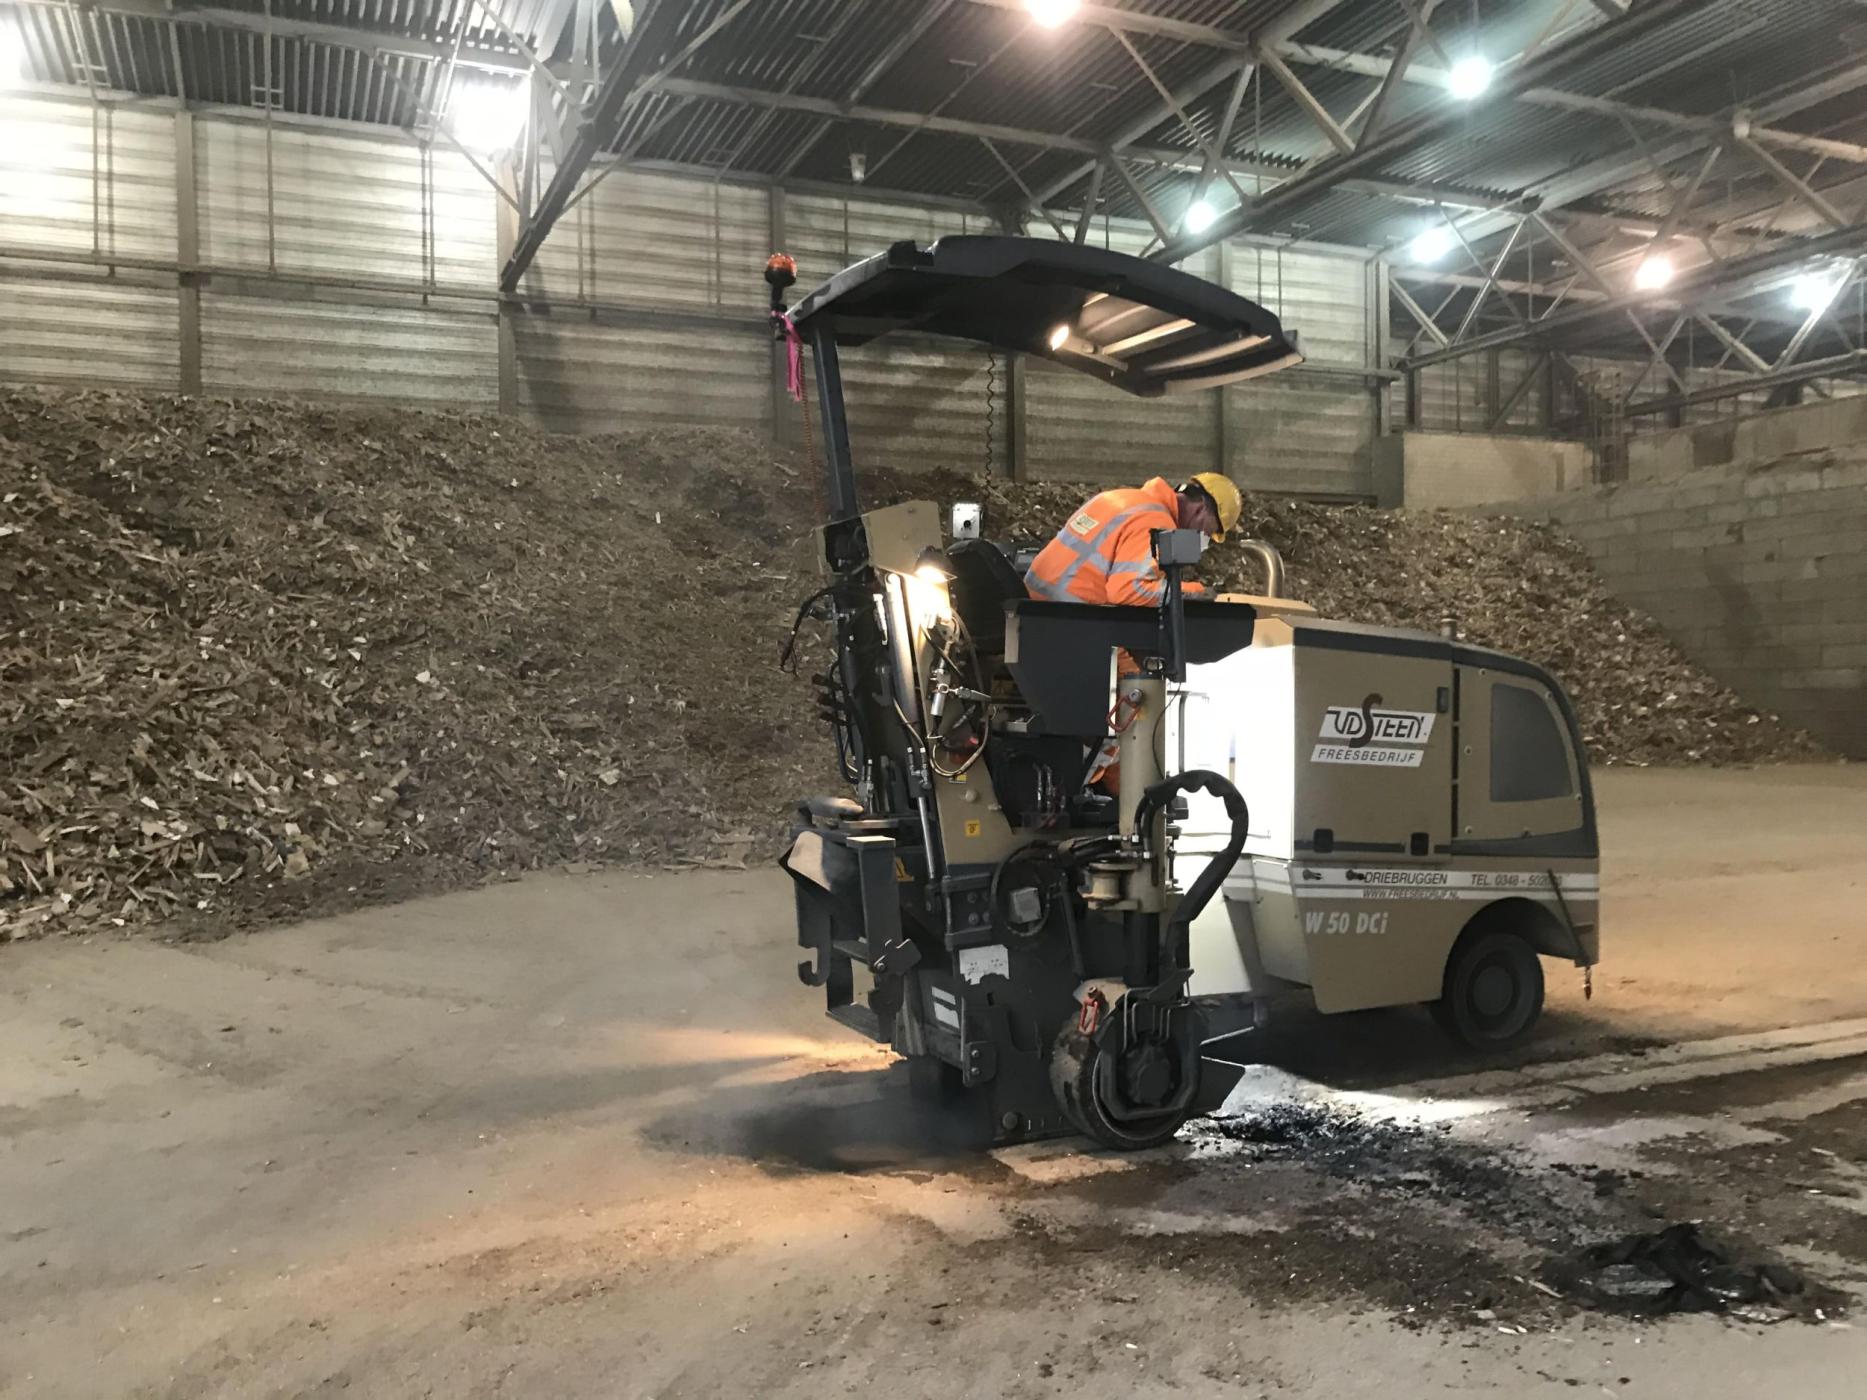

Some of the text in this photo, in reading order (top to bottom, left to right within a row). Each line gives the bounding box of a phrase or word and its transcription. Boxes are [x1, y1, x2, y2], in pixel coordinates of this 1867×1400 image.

[1318, 748, 1416, 763] FREESBEDRIJF
[1363, 871, 1448, 885] DRIEBRUGGEN
[1305, 911, 1325, 934] W
[1326, 911, 1350, 934] 50
